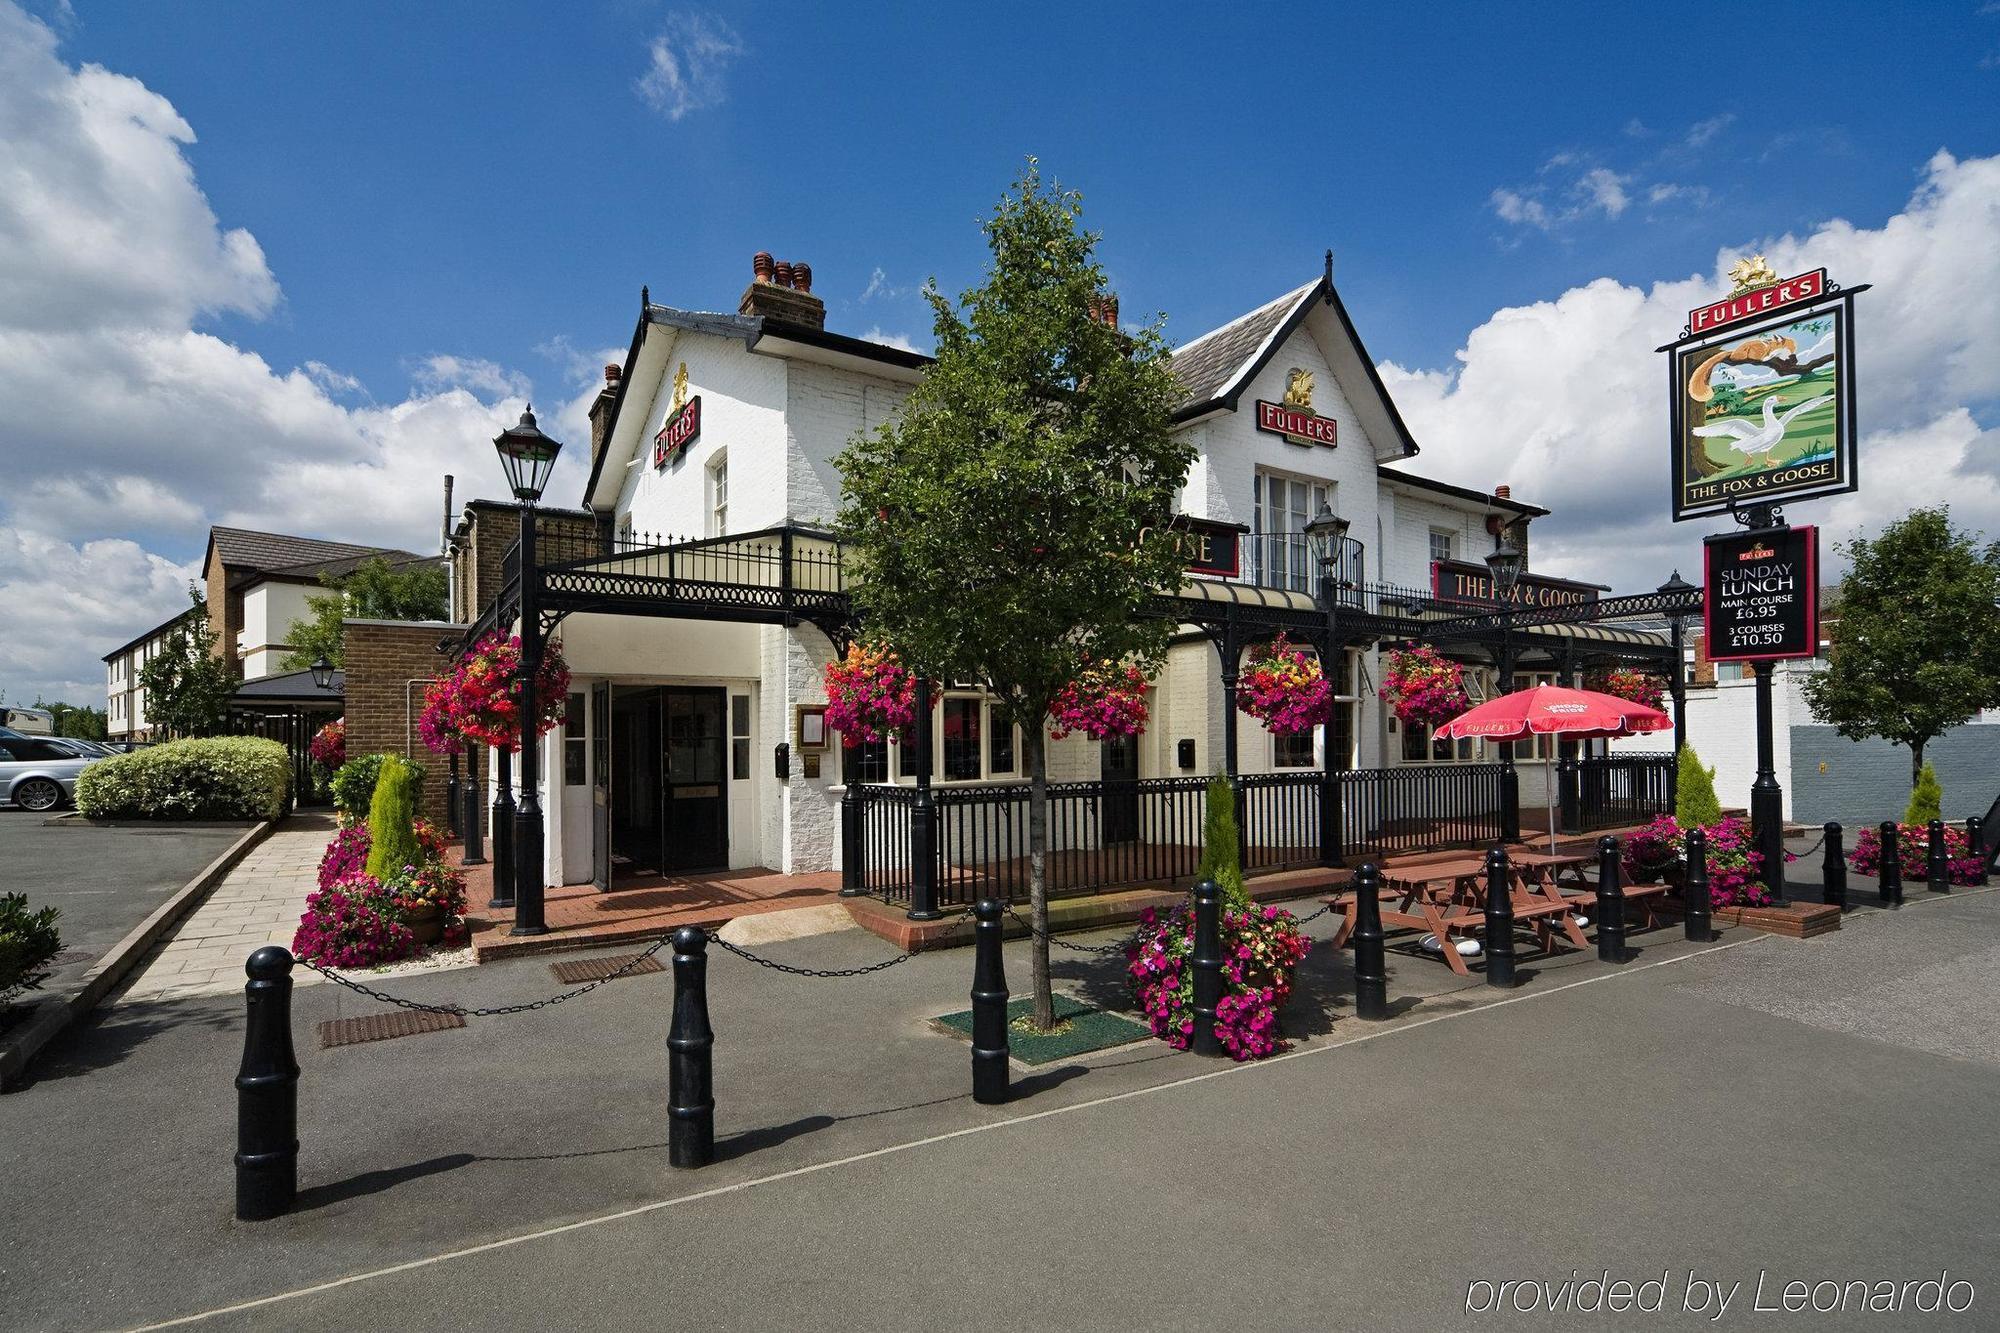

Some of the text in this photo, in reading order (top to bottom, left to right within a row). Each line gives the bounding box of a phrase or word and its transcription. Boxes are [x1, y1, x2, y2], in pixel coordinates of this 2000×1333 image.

[1697, 280, 1812, 328] FULLER'S
[1266, 405, 1333, 440] FULLER'S
[655, 408, 692, 461] FULLER'S
[1690, 463, 1830, 499] THE FOX & GOOSE
[1721, 562, 1793, 582] SUNDAY
[1455, 574, 1487, 599] THE
[1525, 584, 1535, 606] &
[1722, 575, 1793, 597] LUNCH
[1720, 594, 1793, 609] MAIN COURSE
[1736, 605, 1777, 619] £6.95
[1729, 623, 1785, 636] 3 COURSES
[1732, 632, 1783, 647] £10.50
